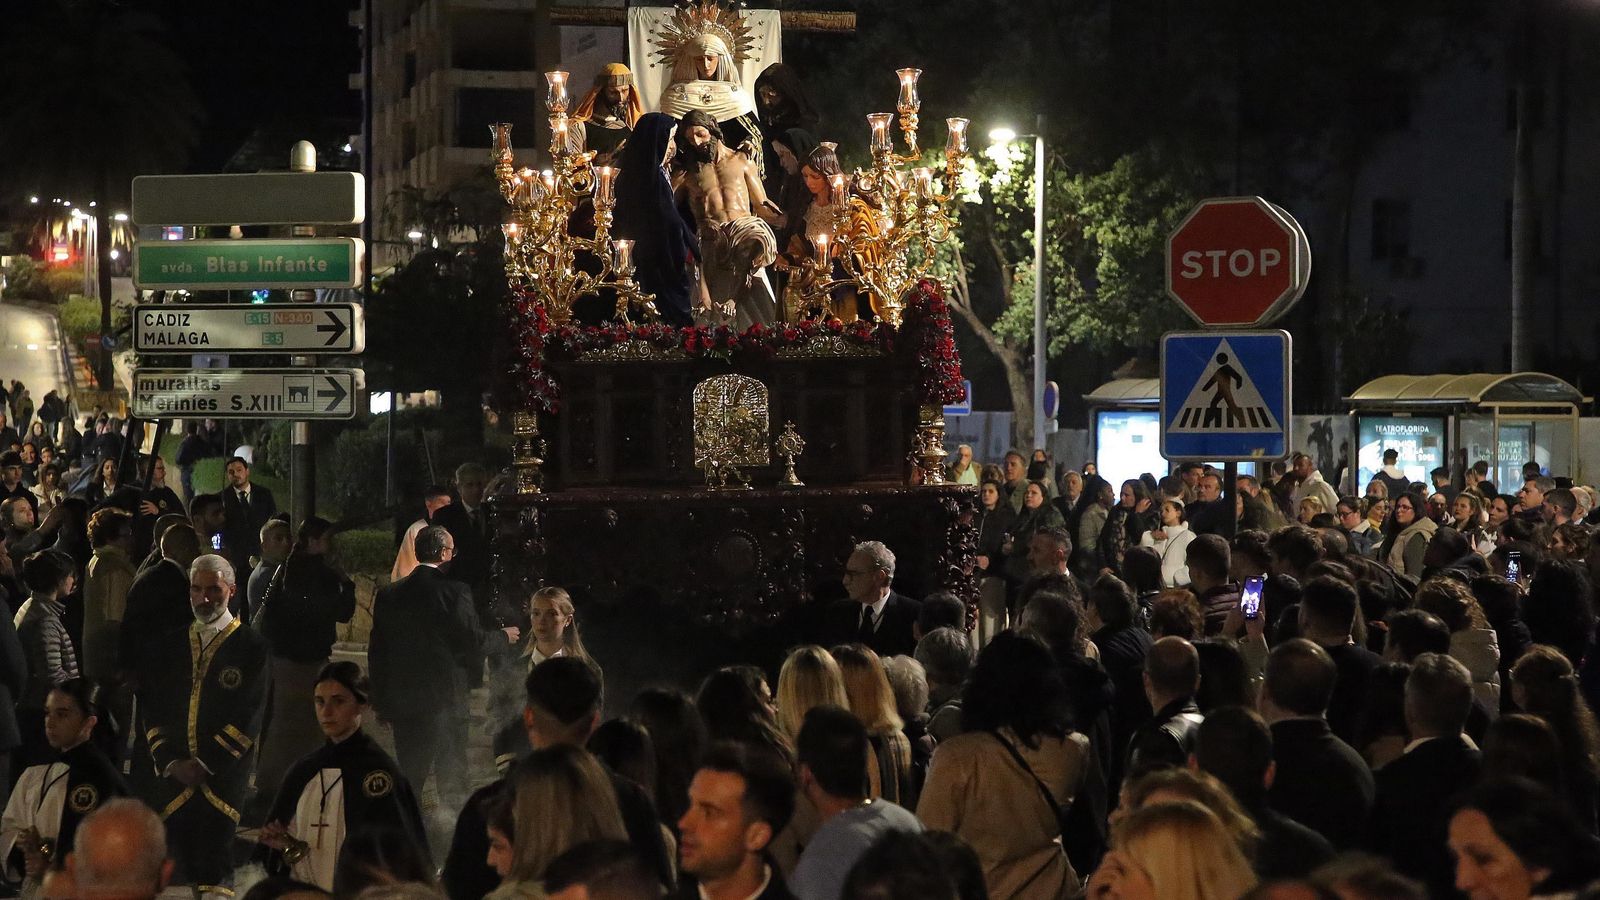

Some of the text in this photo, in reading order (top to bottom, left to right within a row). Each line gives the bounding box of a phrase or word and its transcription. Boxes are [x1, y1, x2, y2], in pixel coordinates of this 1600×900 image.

[206, 256, 249, 273] Blas
[258, 256, 328, 273] Infante
[1180, 248, 1281, 279] STOP
[144, 312, 191, 326] CÁDIZ
[144, 330, 210, 345] MÁLAGA
[139, 376, 221, 391] murallas
[230, 395, 282, 411] S.XIII
